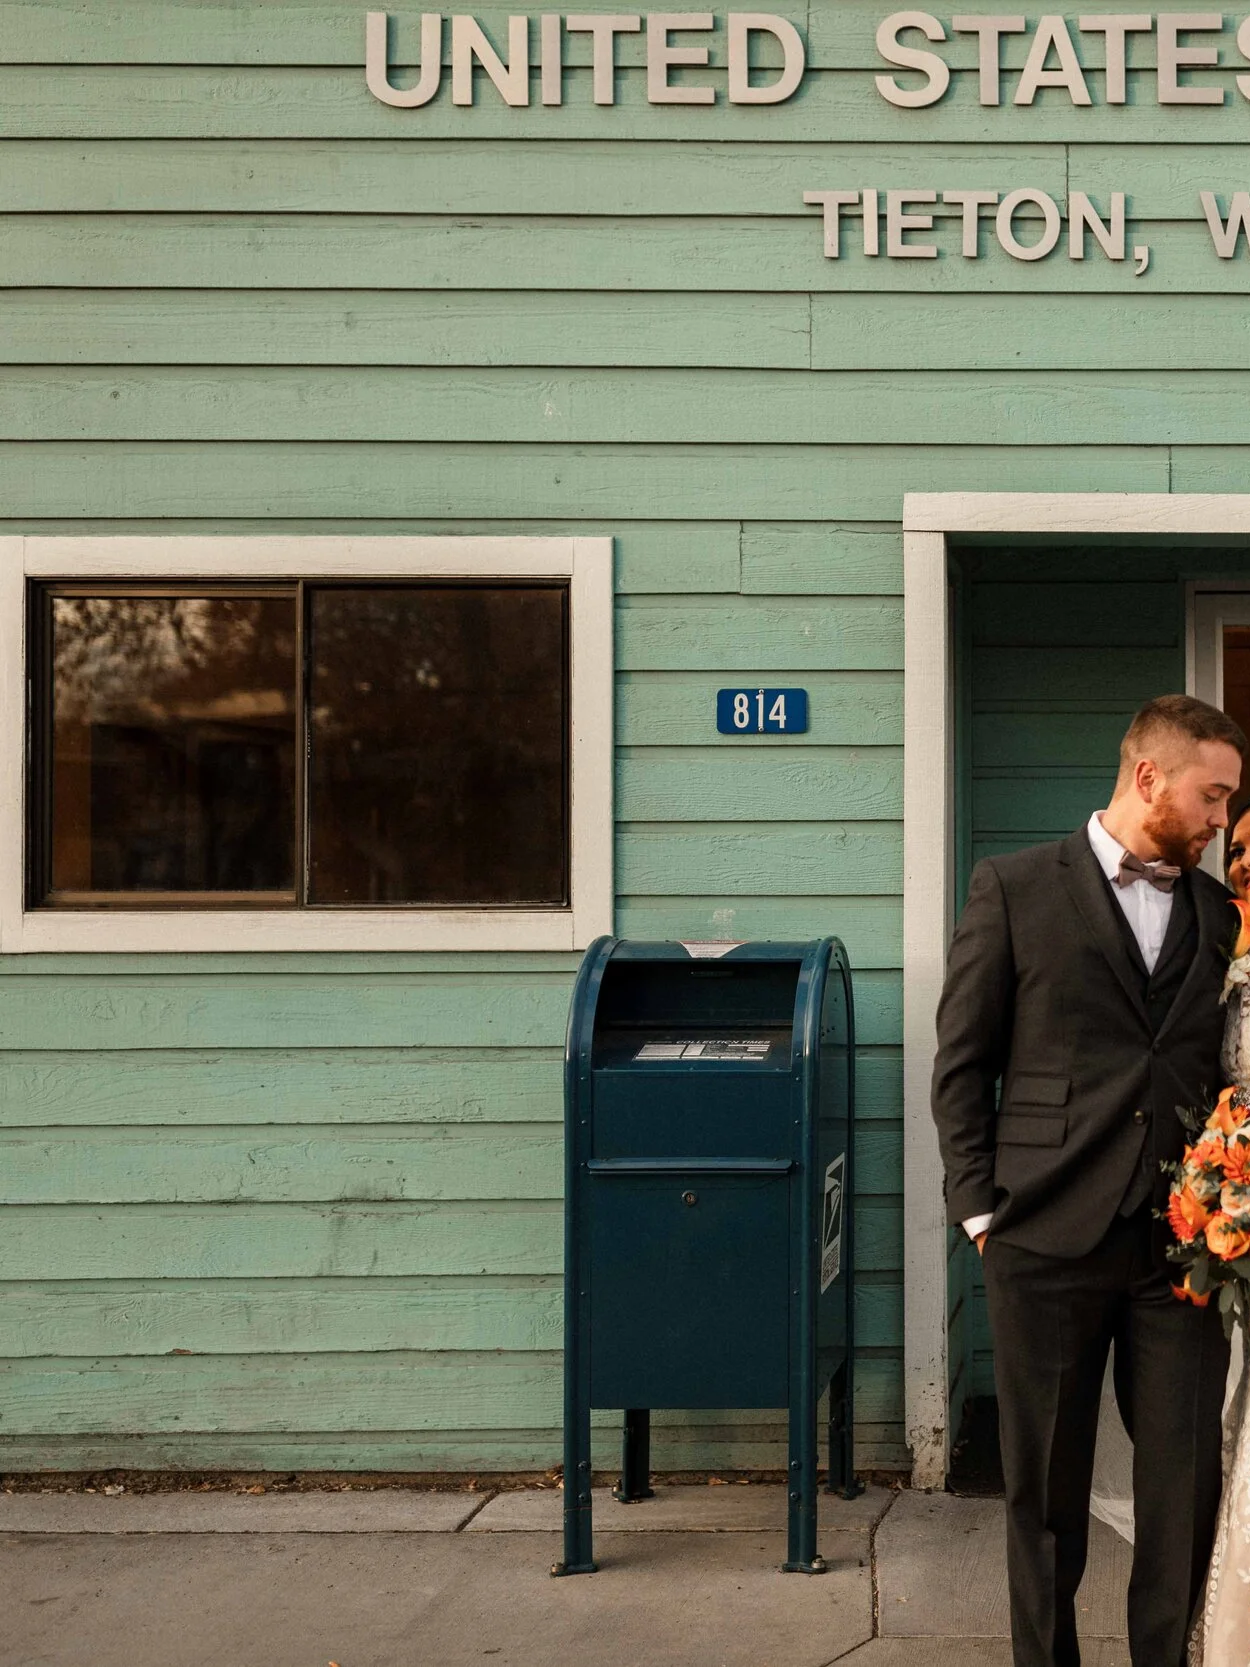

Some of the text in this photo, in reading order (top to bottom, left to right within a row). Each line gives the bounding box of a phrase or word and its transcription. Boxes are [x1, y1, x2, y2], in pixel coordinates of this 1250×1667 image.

[365, 11, 807, 108] UNITED
[802, 187, 1151, 277] TIETON,
[733, 692, 787, 730] 814
